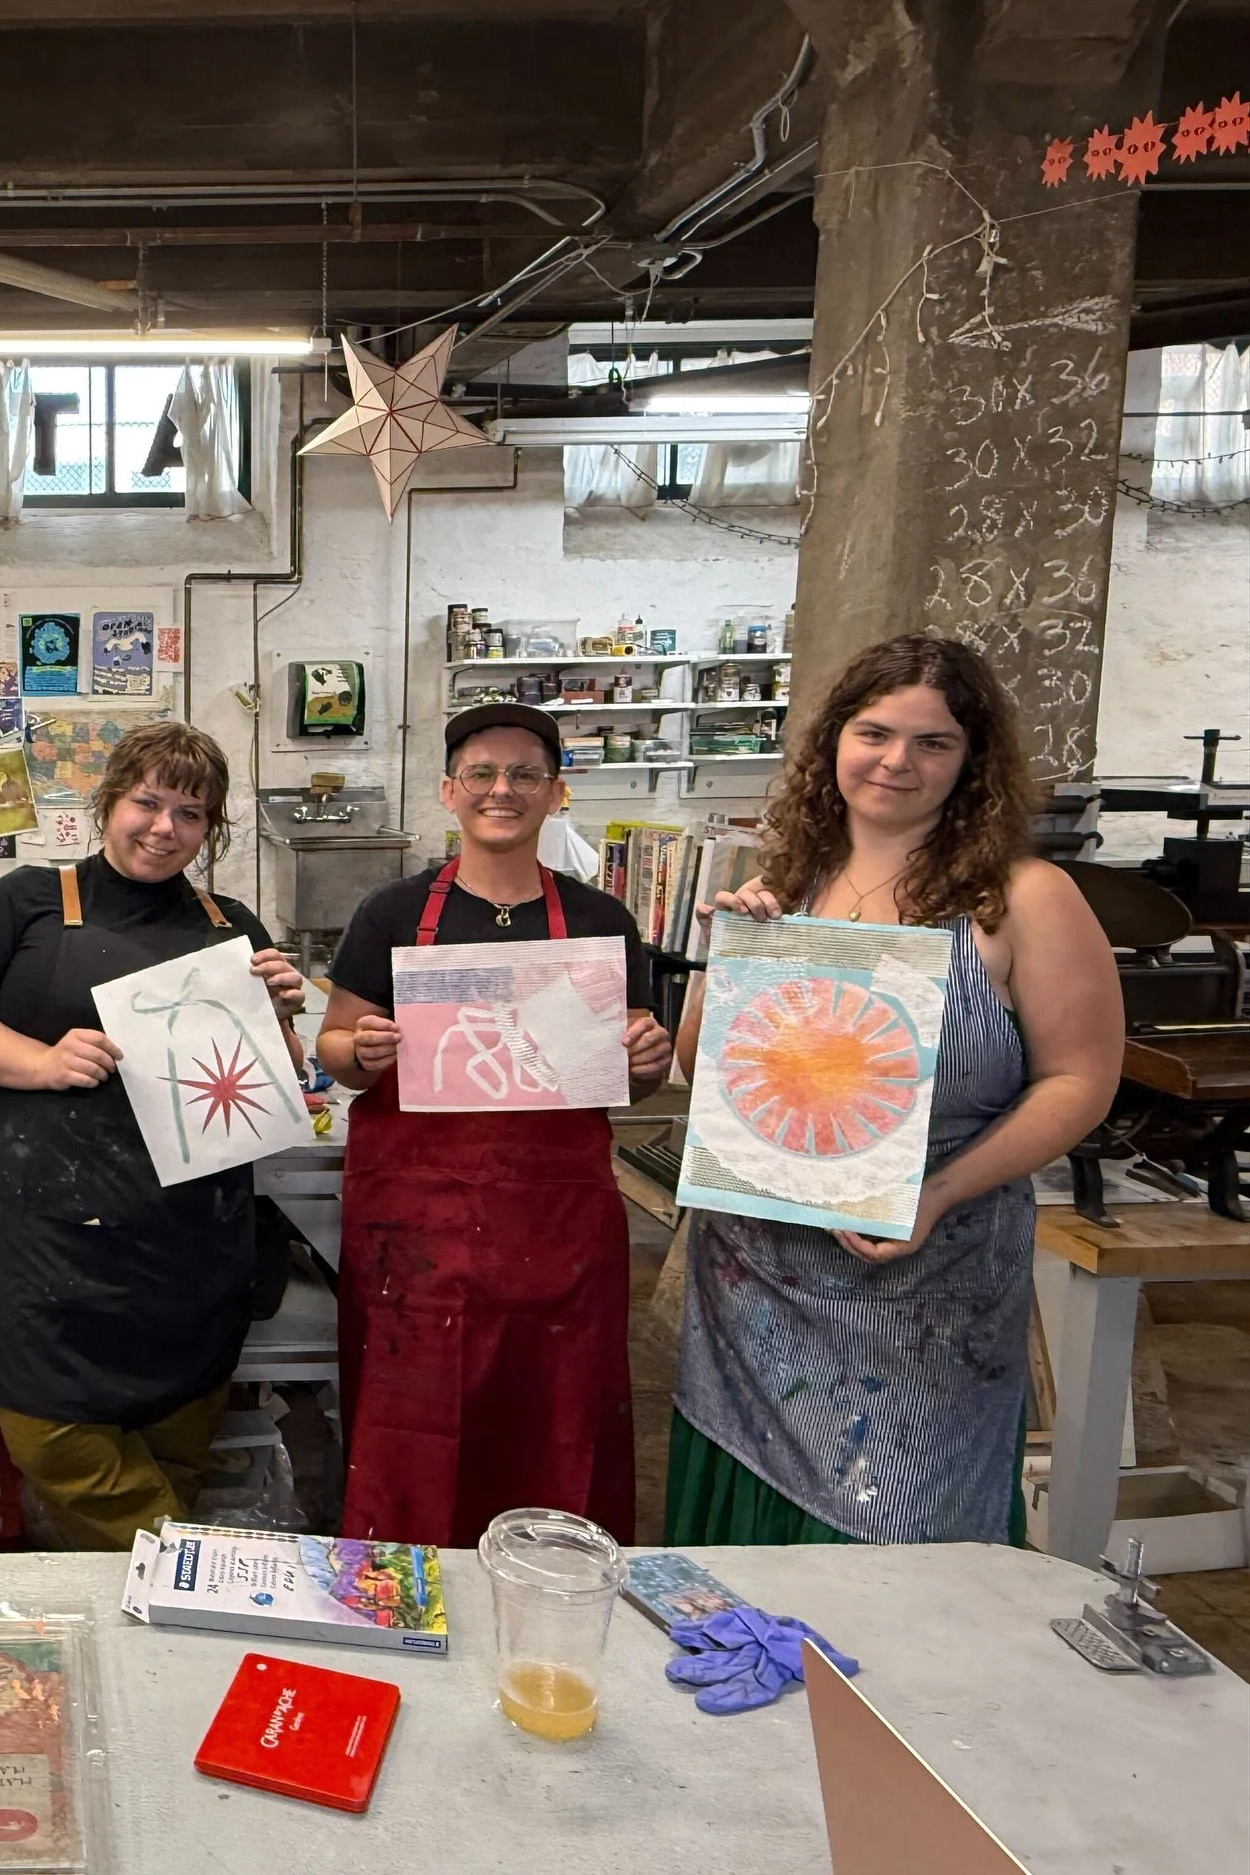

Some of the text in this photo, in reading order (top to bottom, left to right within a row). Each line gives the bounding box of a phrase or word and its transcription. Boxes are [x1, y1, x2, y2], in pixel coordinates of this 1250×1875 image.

[945, 439, 998, 492] 30
[1048, 418, 1109, 468] 32
[1041, 555, 1097, 605] 36
[1038, 619, 1099, 656] 32
